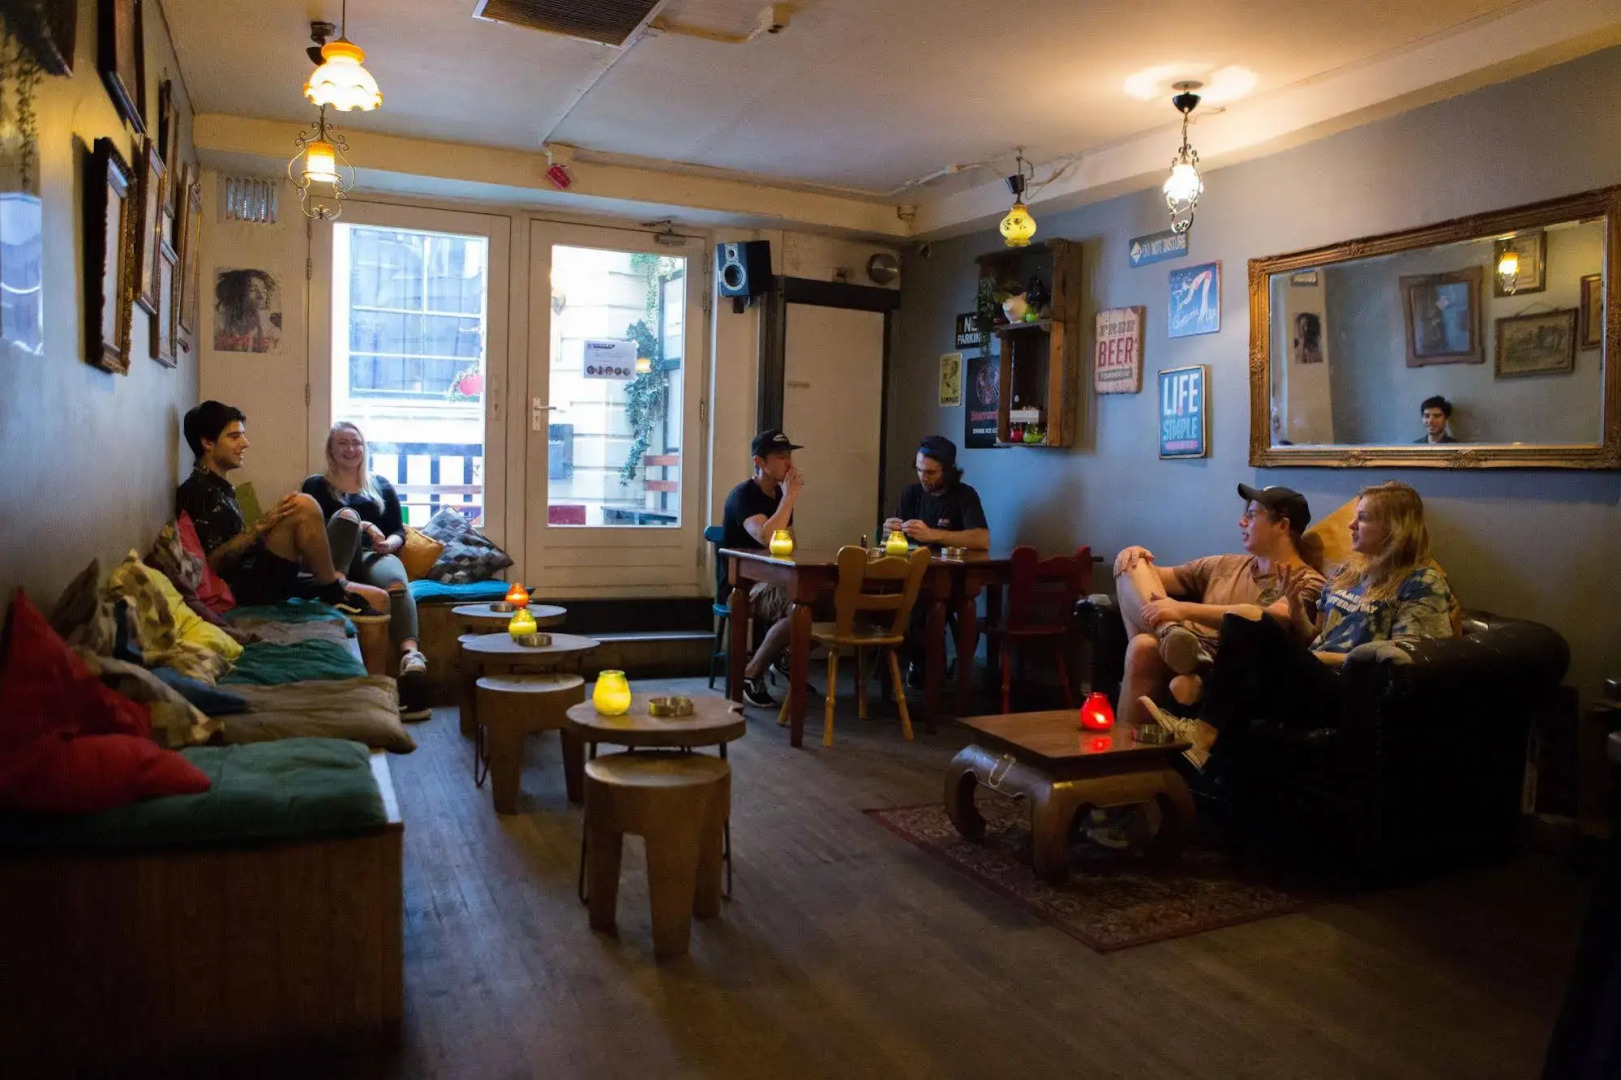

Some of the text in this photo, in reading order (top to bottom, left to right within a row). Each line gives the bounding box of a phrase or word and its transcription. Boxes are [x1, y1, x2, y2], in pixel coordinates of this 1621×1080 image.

[1099, 320, 1135, 337] FREE
[1098, 336, 1133, 368] BEER
[1163, 372, 1199, 416] LIFE
[1163, 416, 1198, 441] SIMPLE
